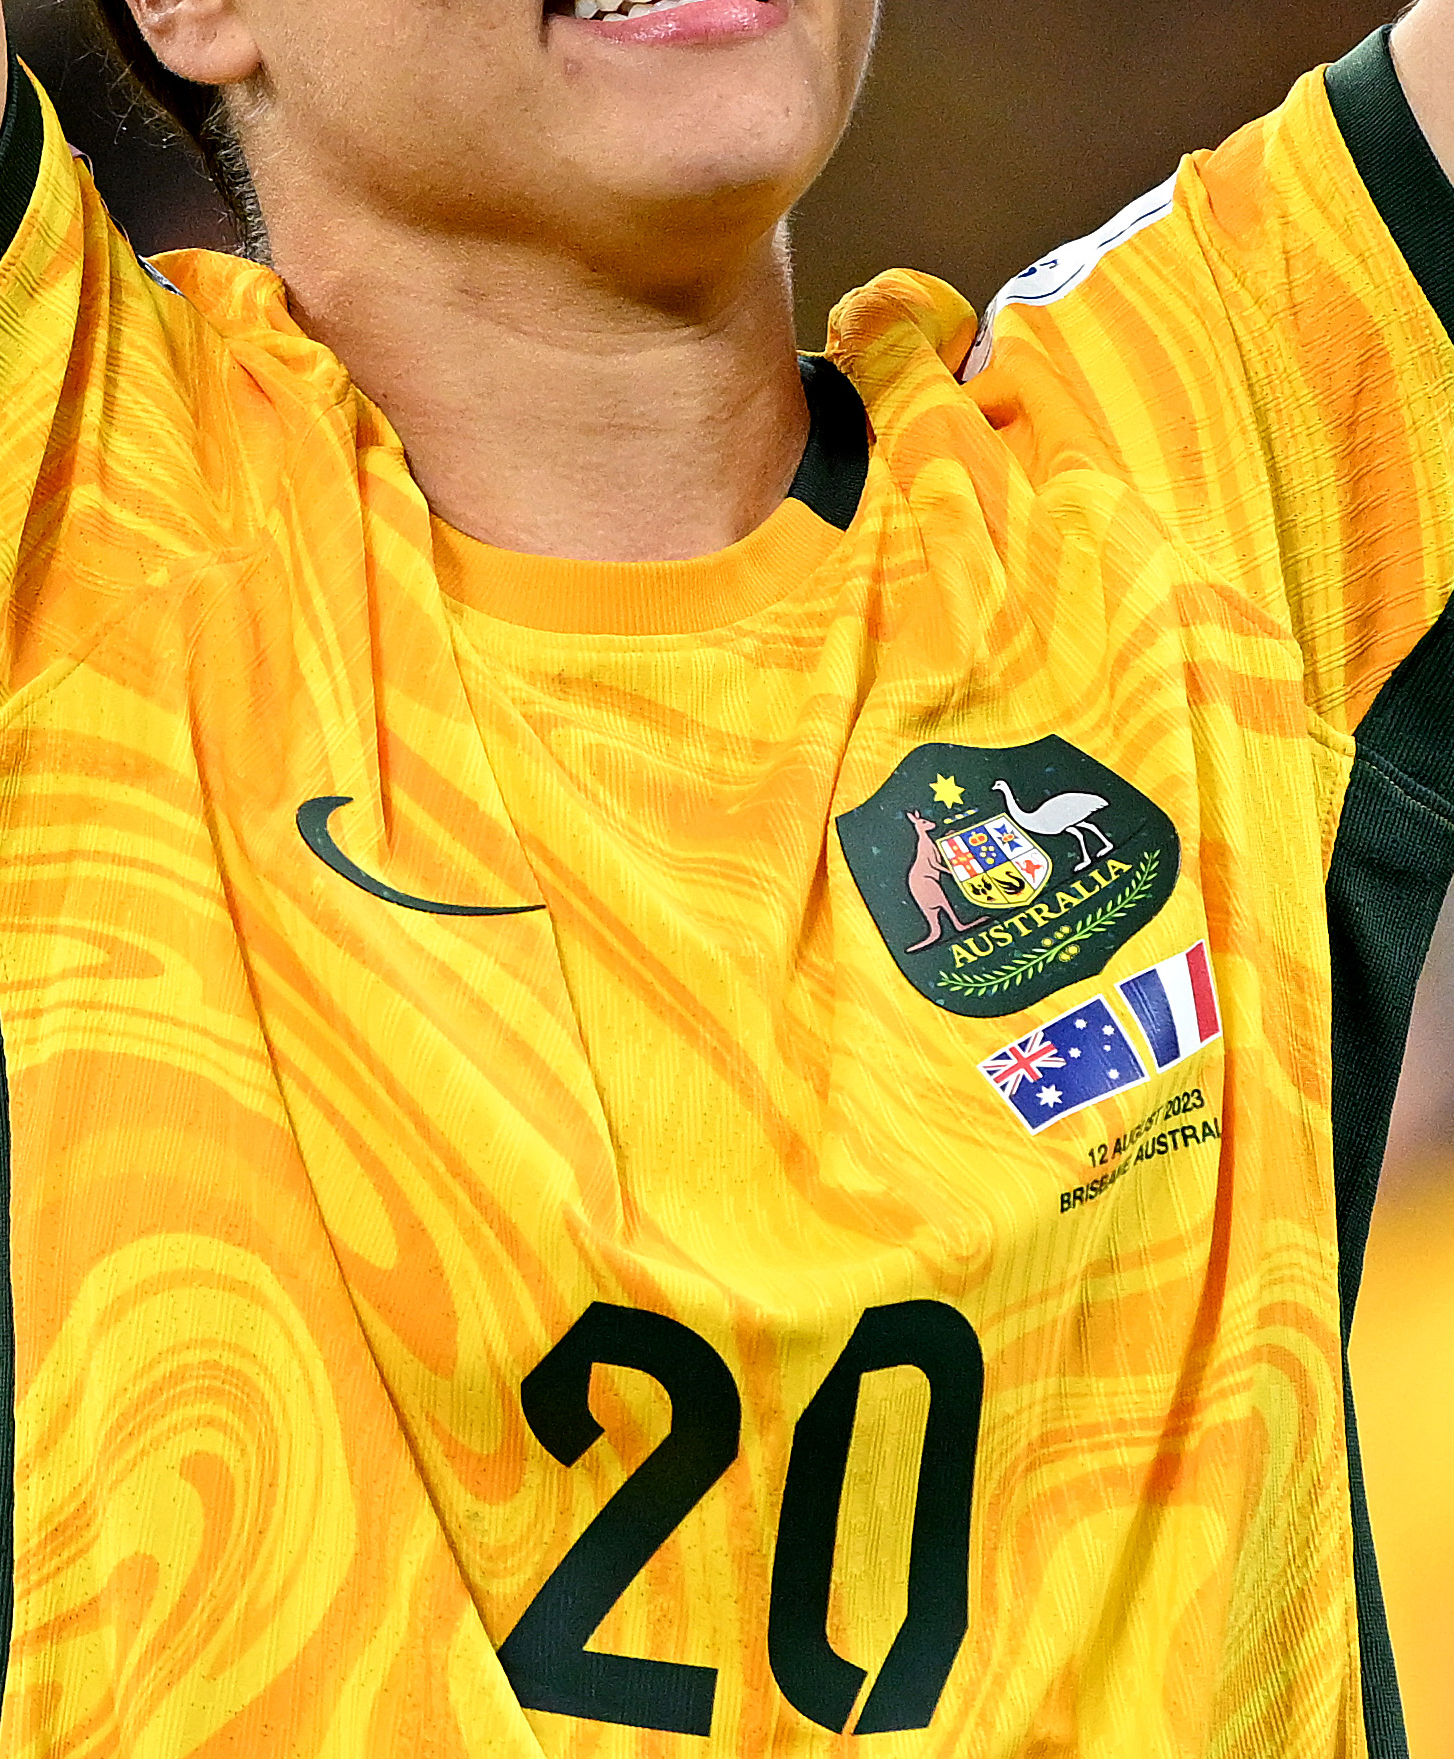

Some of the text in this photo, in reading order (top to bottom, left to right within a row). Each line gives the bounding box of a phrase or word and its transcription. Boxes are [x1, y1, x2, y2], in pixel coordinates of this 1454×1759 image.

[950, 859, 1133, 968] AUSTRALIA
[1088, 1143, 1109, 1168] 12
[1163, 1088, 1205, 1120] 2023
[496, 1299, 984, 1737] 20
